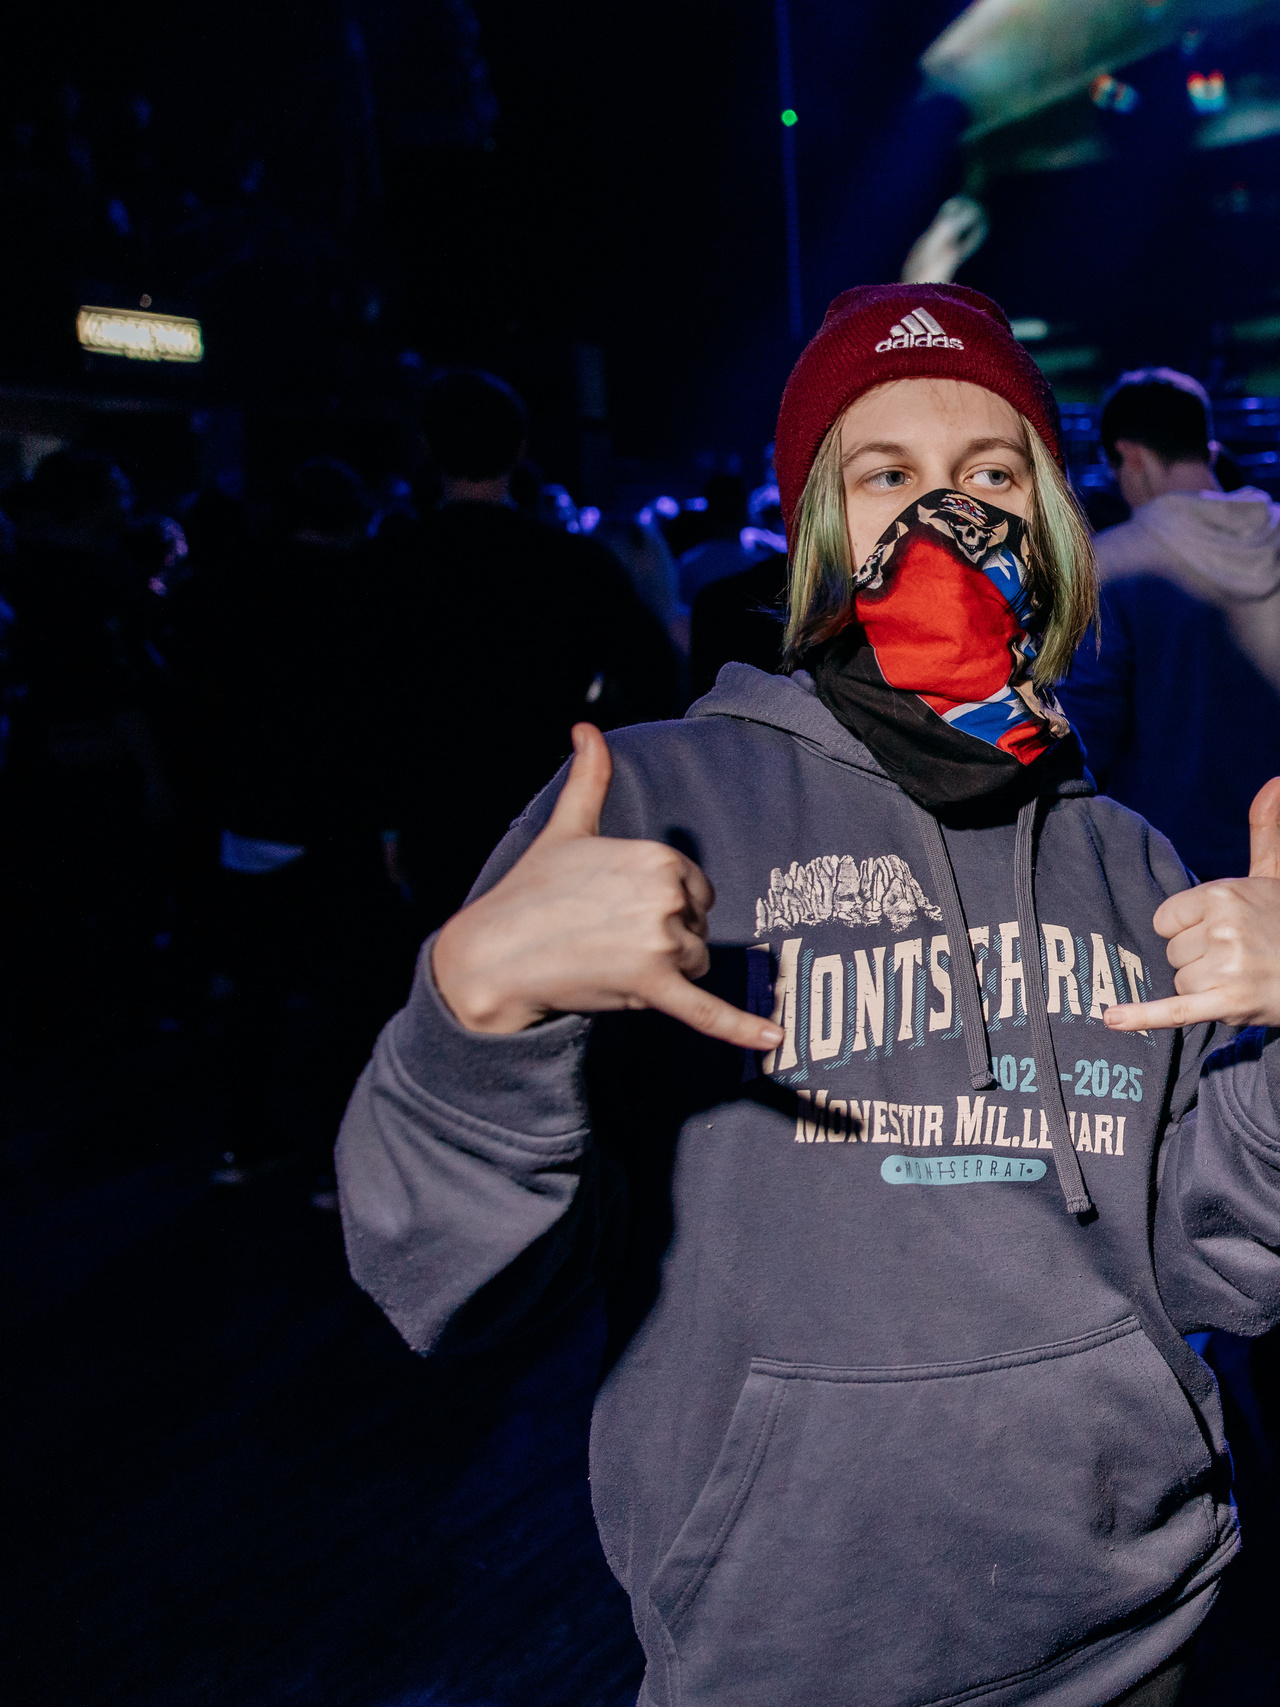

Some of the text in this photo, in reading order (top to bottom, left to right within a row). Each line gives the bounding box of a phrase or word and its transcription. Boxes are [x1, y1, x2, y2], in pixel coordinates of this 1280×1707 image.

[875, 333, 965, 353] adidas
[991, 1054, 1143, 1102] 02-2025
[794, 1089, 945, 1147] MONESTIR
[903, 1158, 1026, 1180] MONTSERRAT
